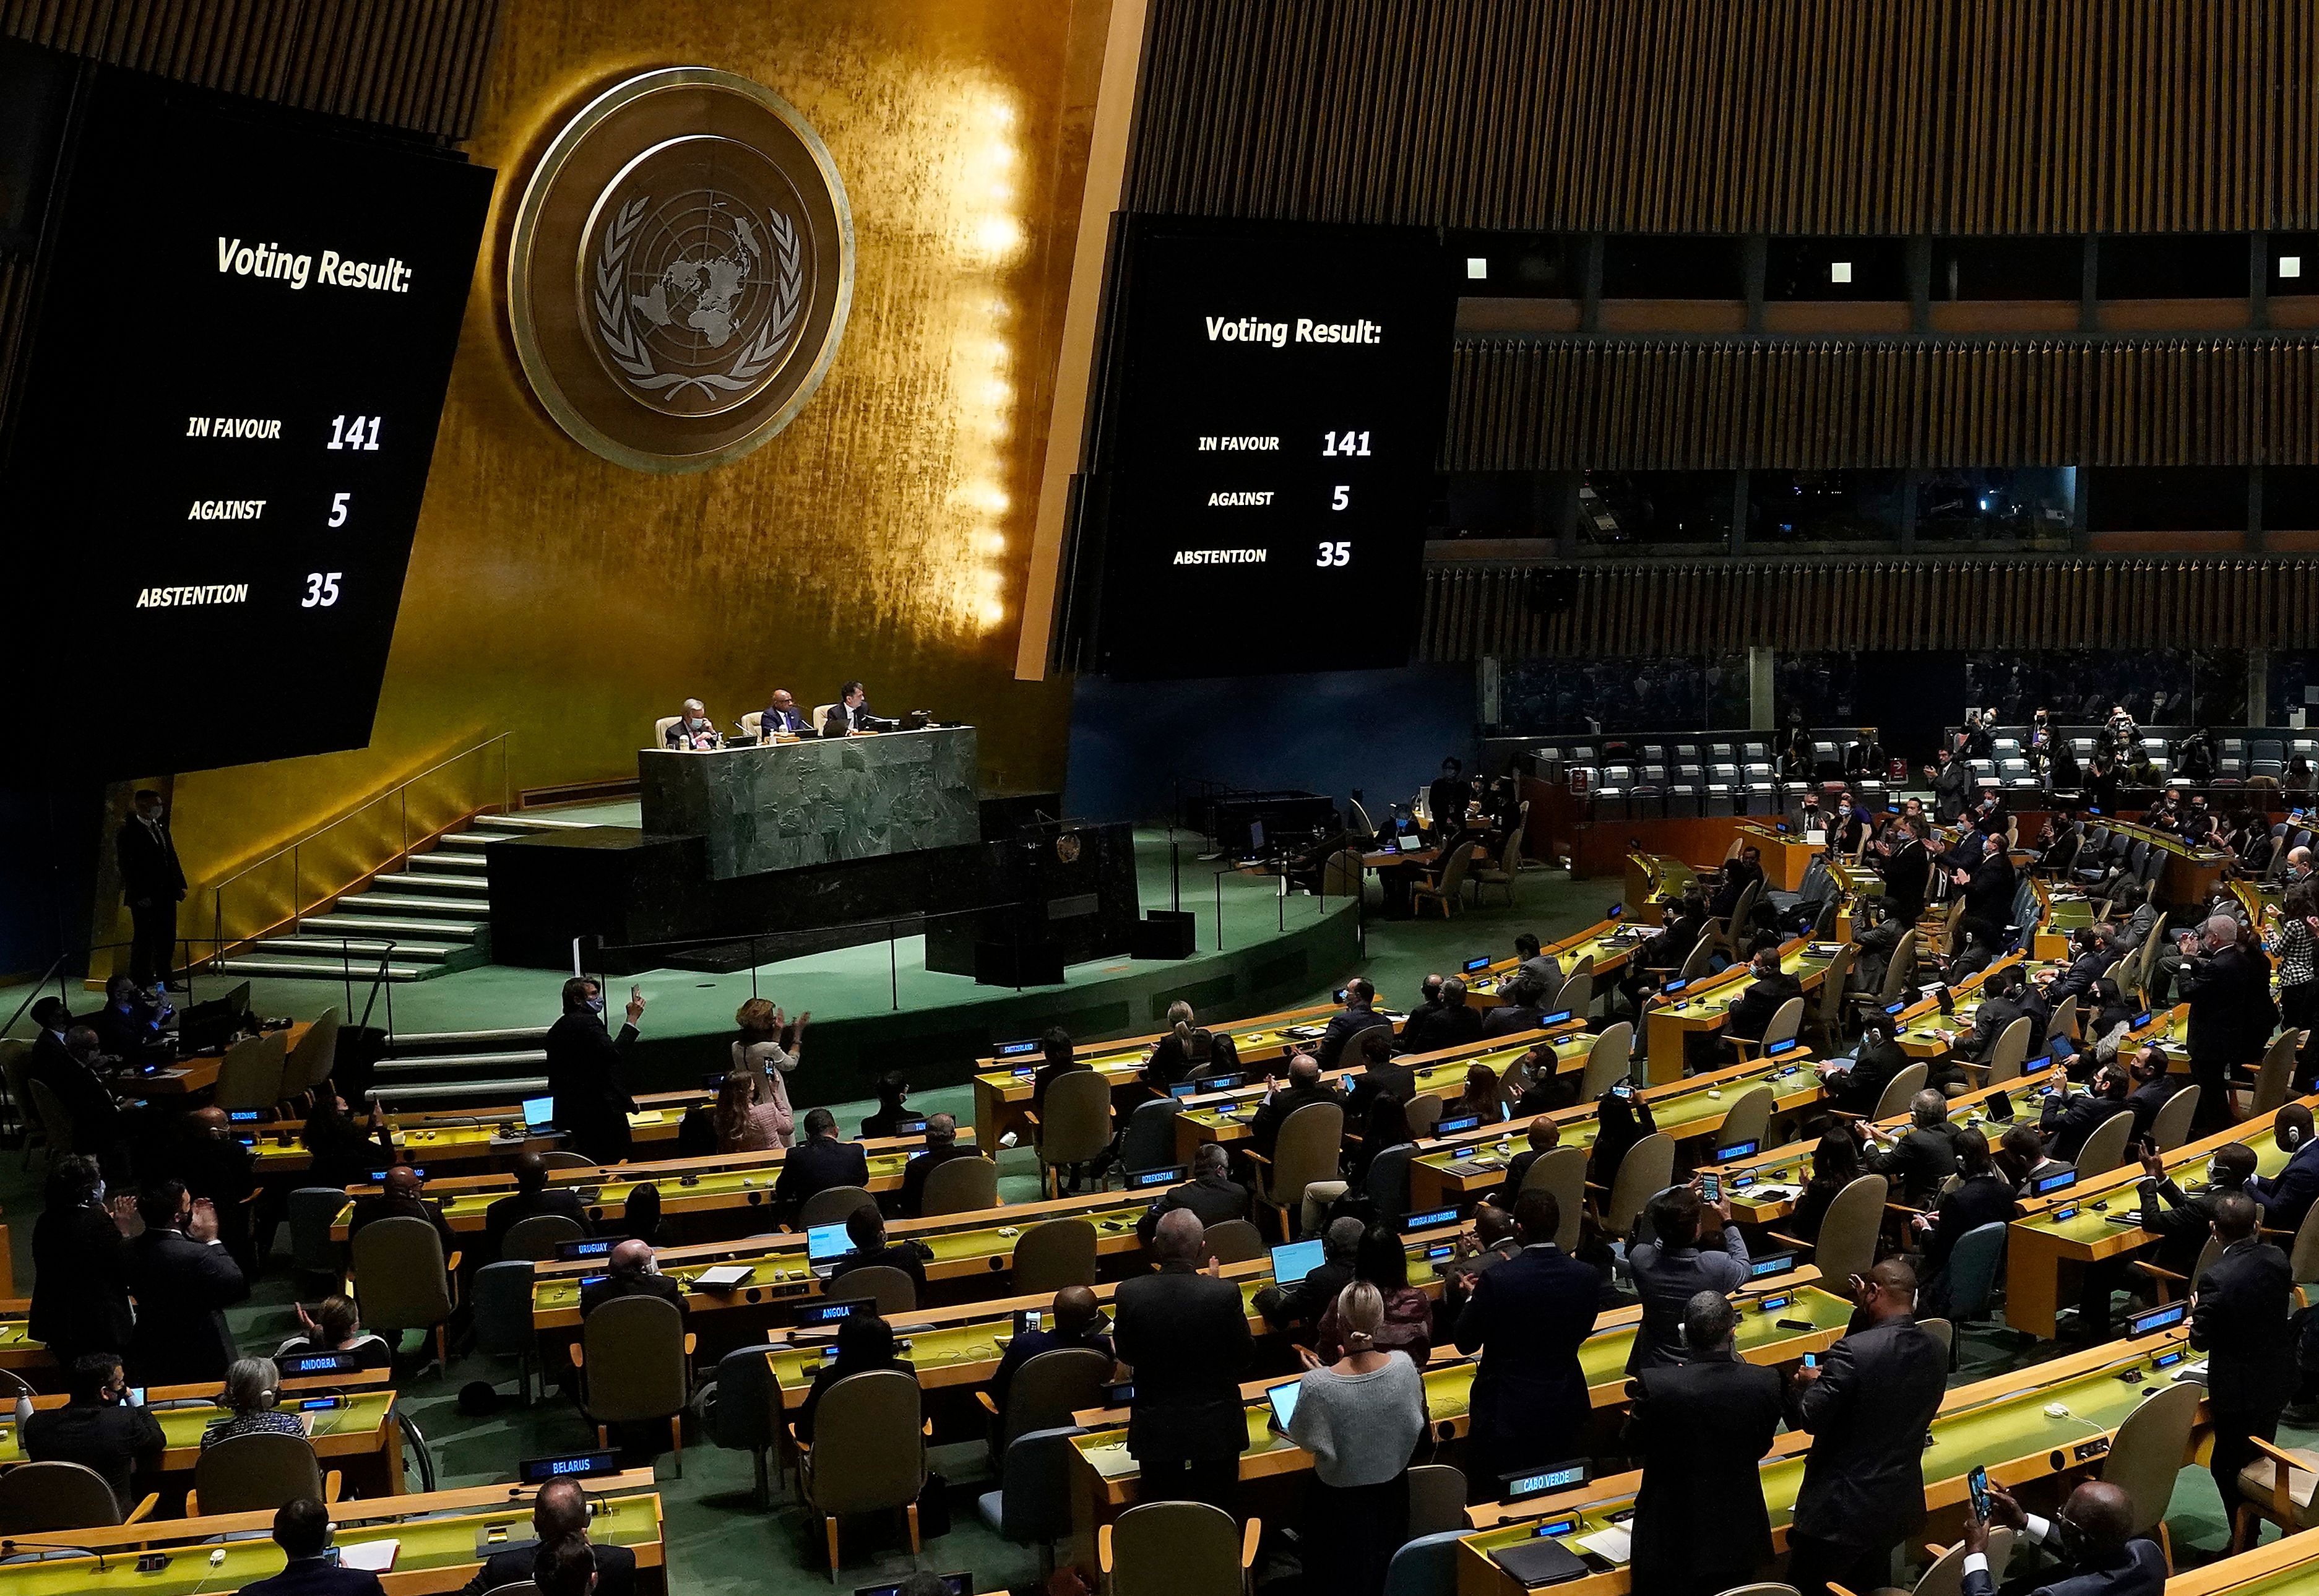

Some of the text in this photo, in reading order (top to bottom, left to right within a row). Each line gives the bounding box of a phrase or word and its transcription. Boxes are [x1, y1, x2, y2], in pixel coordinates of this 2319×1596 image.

[218, 236, 412, 293] Voting Result:
[1206, 316, 1382, 348] Voting Result:
[186, 415, 381, 451] IN FAVOUR 141
[1198, 431, 1371, 456] IN FAVOUR 141
[188, 493, 351, 528] AGAINST 5
[1207, 485, 1350, 511] AGAINST 5
[1173, 541, 1351, 567] ABSTENTION 35
[136, 572, 342, 608] ABSTENTION 35
[1141, 1170, 1174, 1184] UZBEKISTAN
[579, 1242, 608, 1254] URUGUAY
[1758, 1260, 1776, 1275] BELIZE
[822, 1305, 850, 1319] ANGOLA
[300, 1357, 337, 1371] ANDORRA
[552, 1458, 591, 1475] BELARUS
[1523, 1470, 1570, 1493] CABO VERDE
